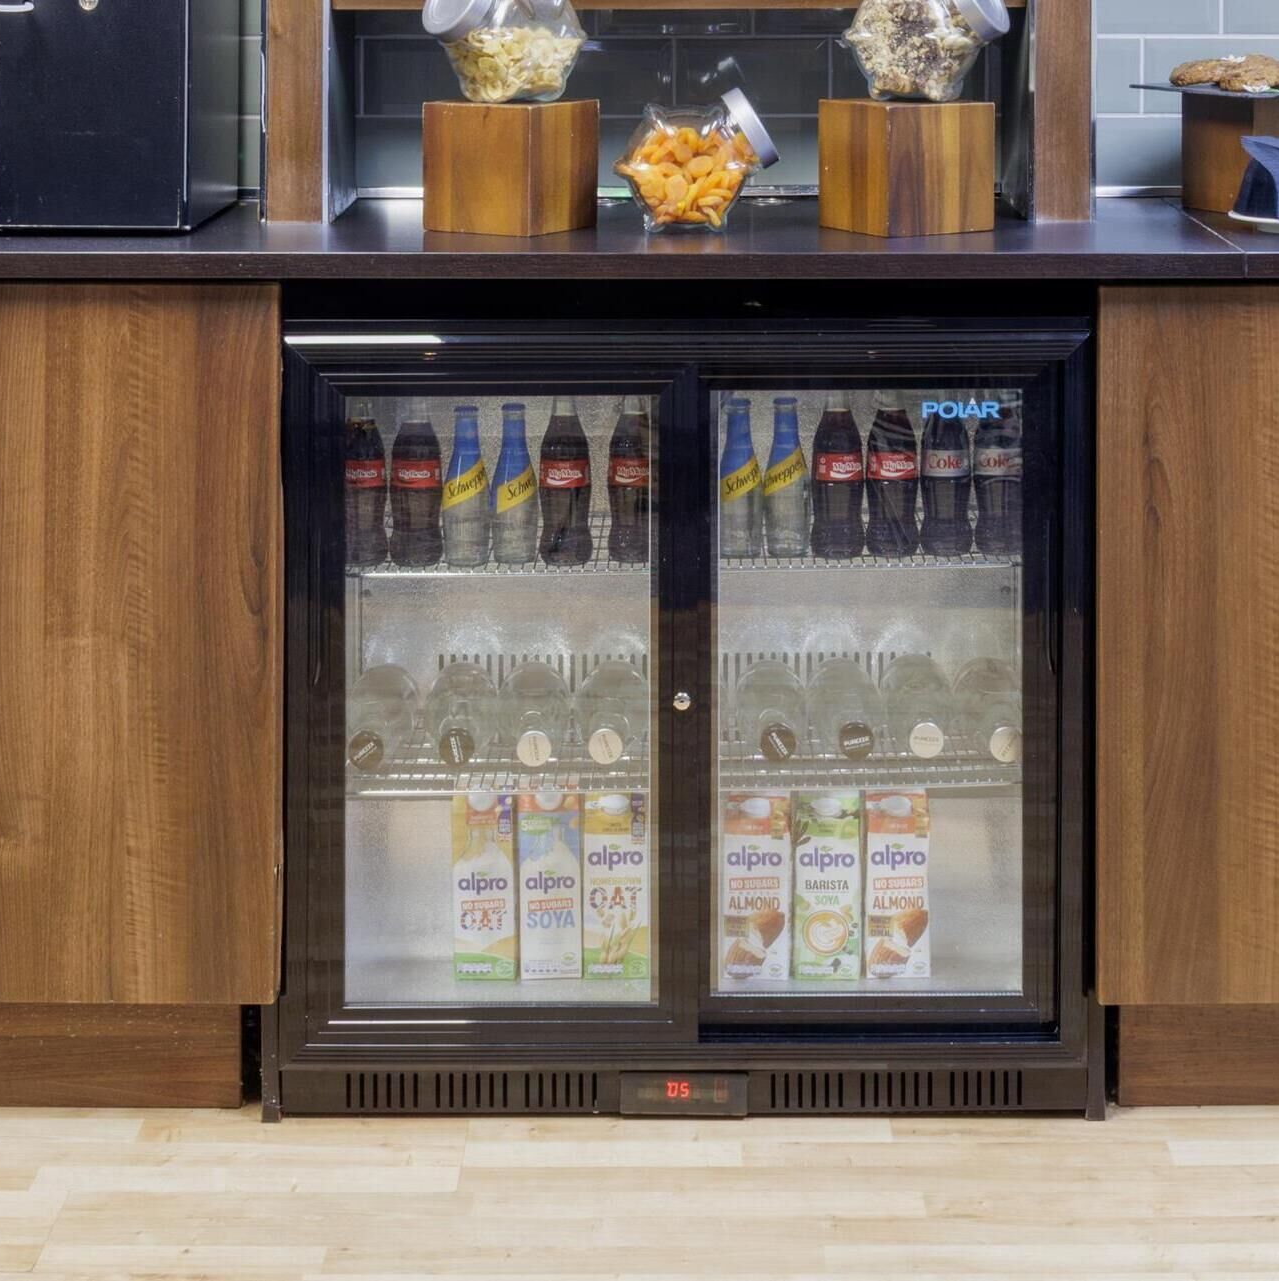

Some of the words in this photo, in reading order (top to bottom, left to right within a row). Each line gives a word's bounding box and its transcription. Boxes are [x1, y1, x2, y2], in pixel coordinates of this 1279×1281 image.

[921, 397, 1001, 419] POLAR
[928, 453, 963, 469] Coke
[587, 844, 644, 871] alpro
[727, 845, 782, 871] alpro
[799, 846, 855, 873] alpro
[870, 844, 927, 871] alpro
[458, 871, 508, 896] alpro
[525, 871, 576, 895] alpro
[730, 879, 743, 889] NO
[744, 878, 779, 889] SUGARS
[805, 879, 849, 891] BARISTA
[874, 879, 886, 889] NO
[887, 878, 923, 889] SUGARS
[589, 886, 643, 910] OAT
[729, 896, 781, 911] ALMOND
[814, 895, 840, 906] SOYA
[873, 896, 924, 910] ALMOND
[461, 909, 507, 931] OAT
[526, 909, 576, 929] SOYA
